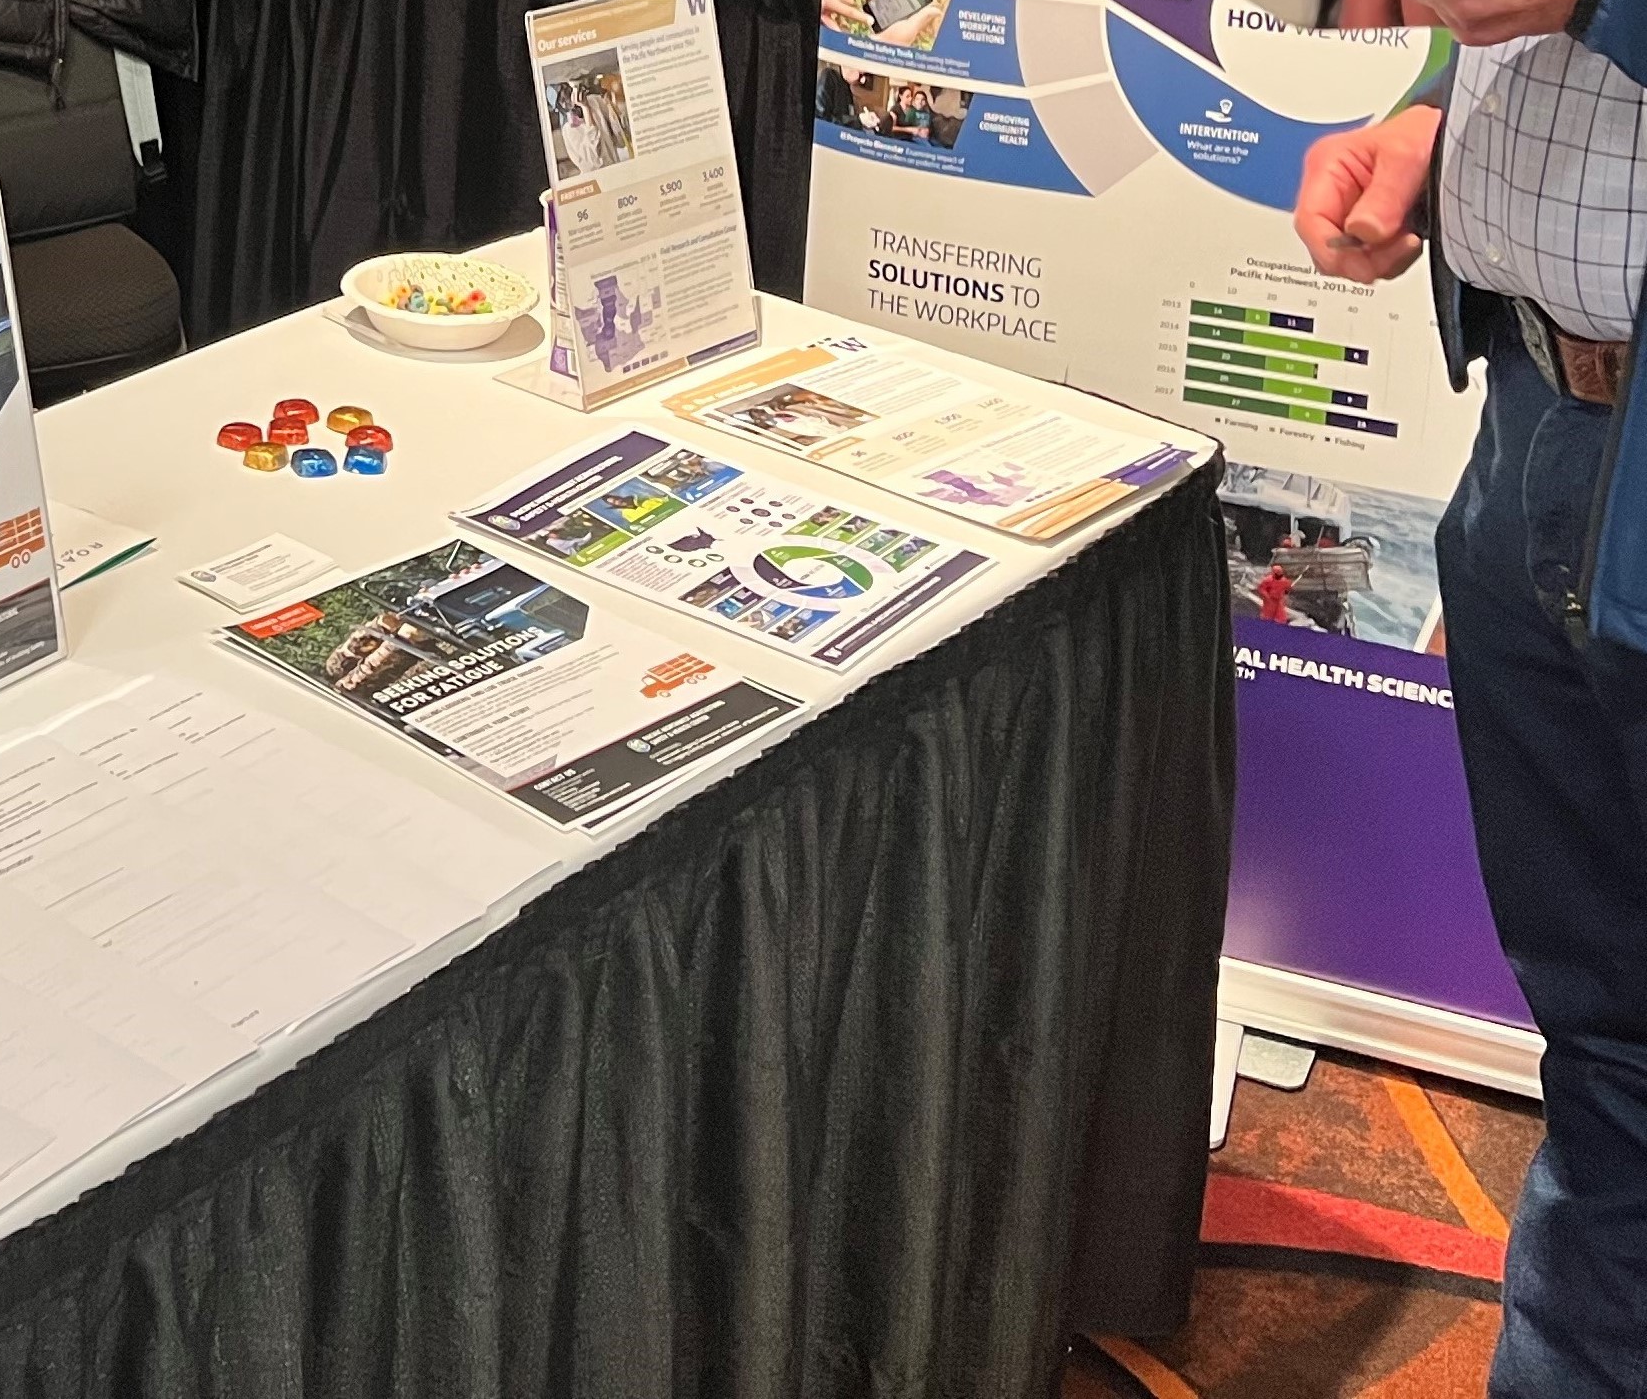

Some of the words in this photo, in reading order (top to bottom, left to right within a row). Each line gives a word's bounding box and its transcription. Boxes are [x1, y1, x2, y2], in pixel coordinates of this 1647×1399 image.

[958, 10, 1007, 25] DEVELOPING
[1227, 9, 1287, 33] HOW
[959, 20, 1006, 35] WORKPLACE
[537, 36, 558, 53] Our
[557, 27, 597, 48] services
[961, 31, 1006, 45] SOLUTIONS
[983, 112, 1030, 127] IMPROVING
[979, 122, 1030, 137] COMMUNITY
[1179, 122, 1259, 144] INTERVENTION
[999, 134, 1029, 147] HEALTH
[1187, 140, 1213, 154] What
[1215, 145, 1232, 154] are
[1232, 144, 1249, 156] the
[1193, 151, 1242, 165] solutions?
[576, 208, 589, 223] 96
[870, 227, 1042, 278] TRANSFERRING
[1246, 256, 1312, 275] Occupational
[868, 259, 1004, 302] SOLUTIONS
[1010, 285, 1040, 309] TO
[1230, 267, 1263, 281] Pacific
[1264, 273, 1321, 291] Northwest,
[866, 288, 909, 316] THE
[914, 298, 1057, 343] WORKPLACE
[1224, 417, 1258, 431] Farming
[1279, 427, 1315, 441] Forestry
[372, 662, 449, 704] SEEKING
[448, 625, 547, 673] SOLUTIONS
[1232, 645, 1266, 669] AL
[1269, 653, 1363, 689] HEALTH
[1366, 673, 1454, 711] SCIENC
[388, 685, 430, 715] FOR
[430, 659, 505, 700] FATIGUE
